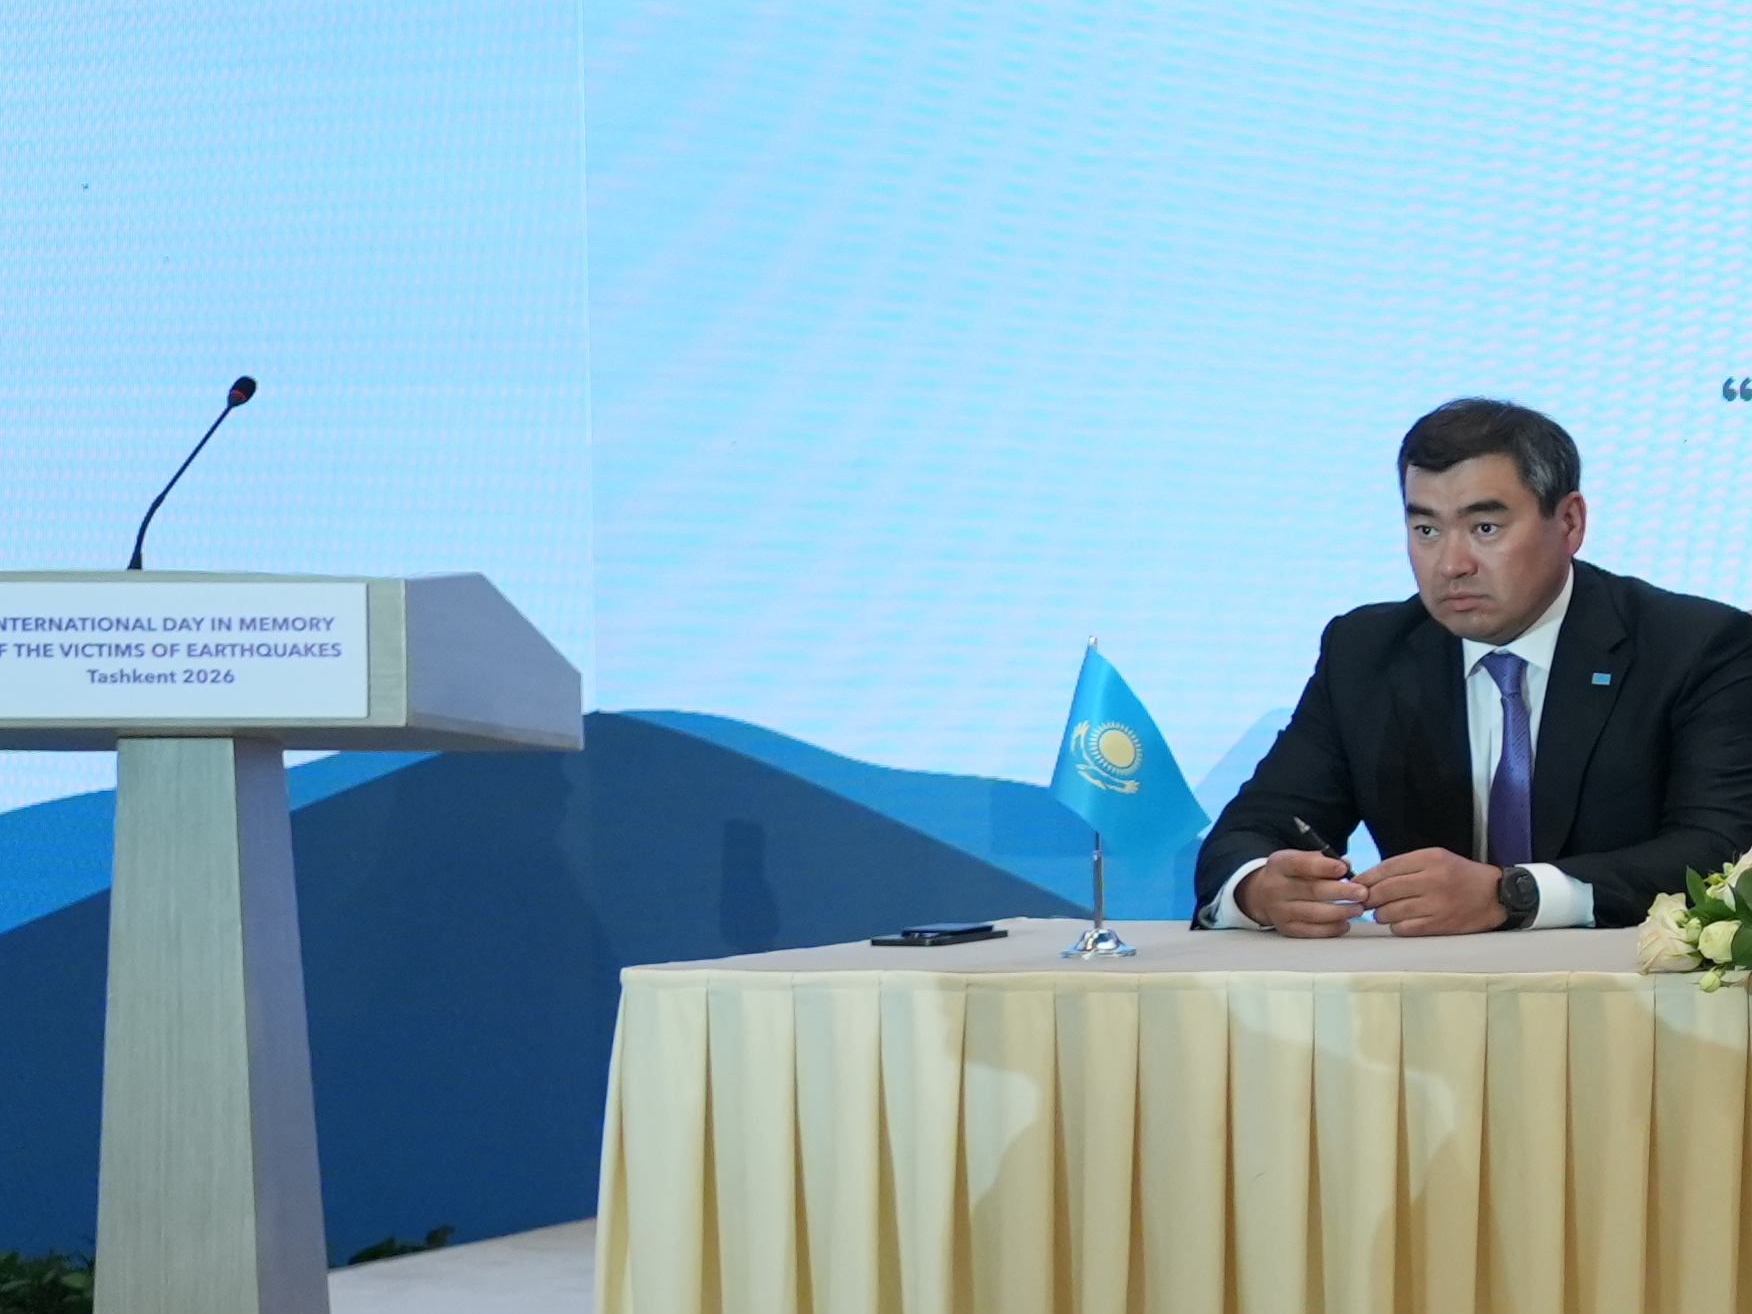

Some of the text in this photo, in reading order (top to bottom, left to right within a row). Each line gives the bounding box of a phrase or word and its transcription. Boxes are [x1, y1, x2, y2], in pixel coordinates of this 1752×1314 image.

[163, 617, 205, 632] DAY
[211, 617, 232, 632] IN
[239, 617, 335, 632] MEMORY
[13, 643, 54, 658] THE
[60, 643, 145, 658] VICTIMS
[152, 643, 181, 658] OF
[187, 642, 342, 658] EARTHQUAKES
[86, 669, 235, 684] Tashkent 2026
